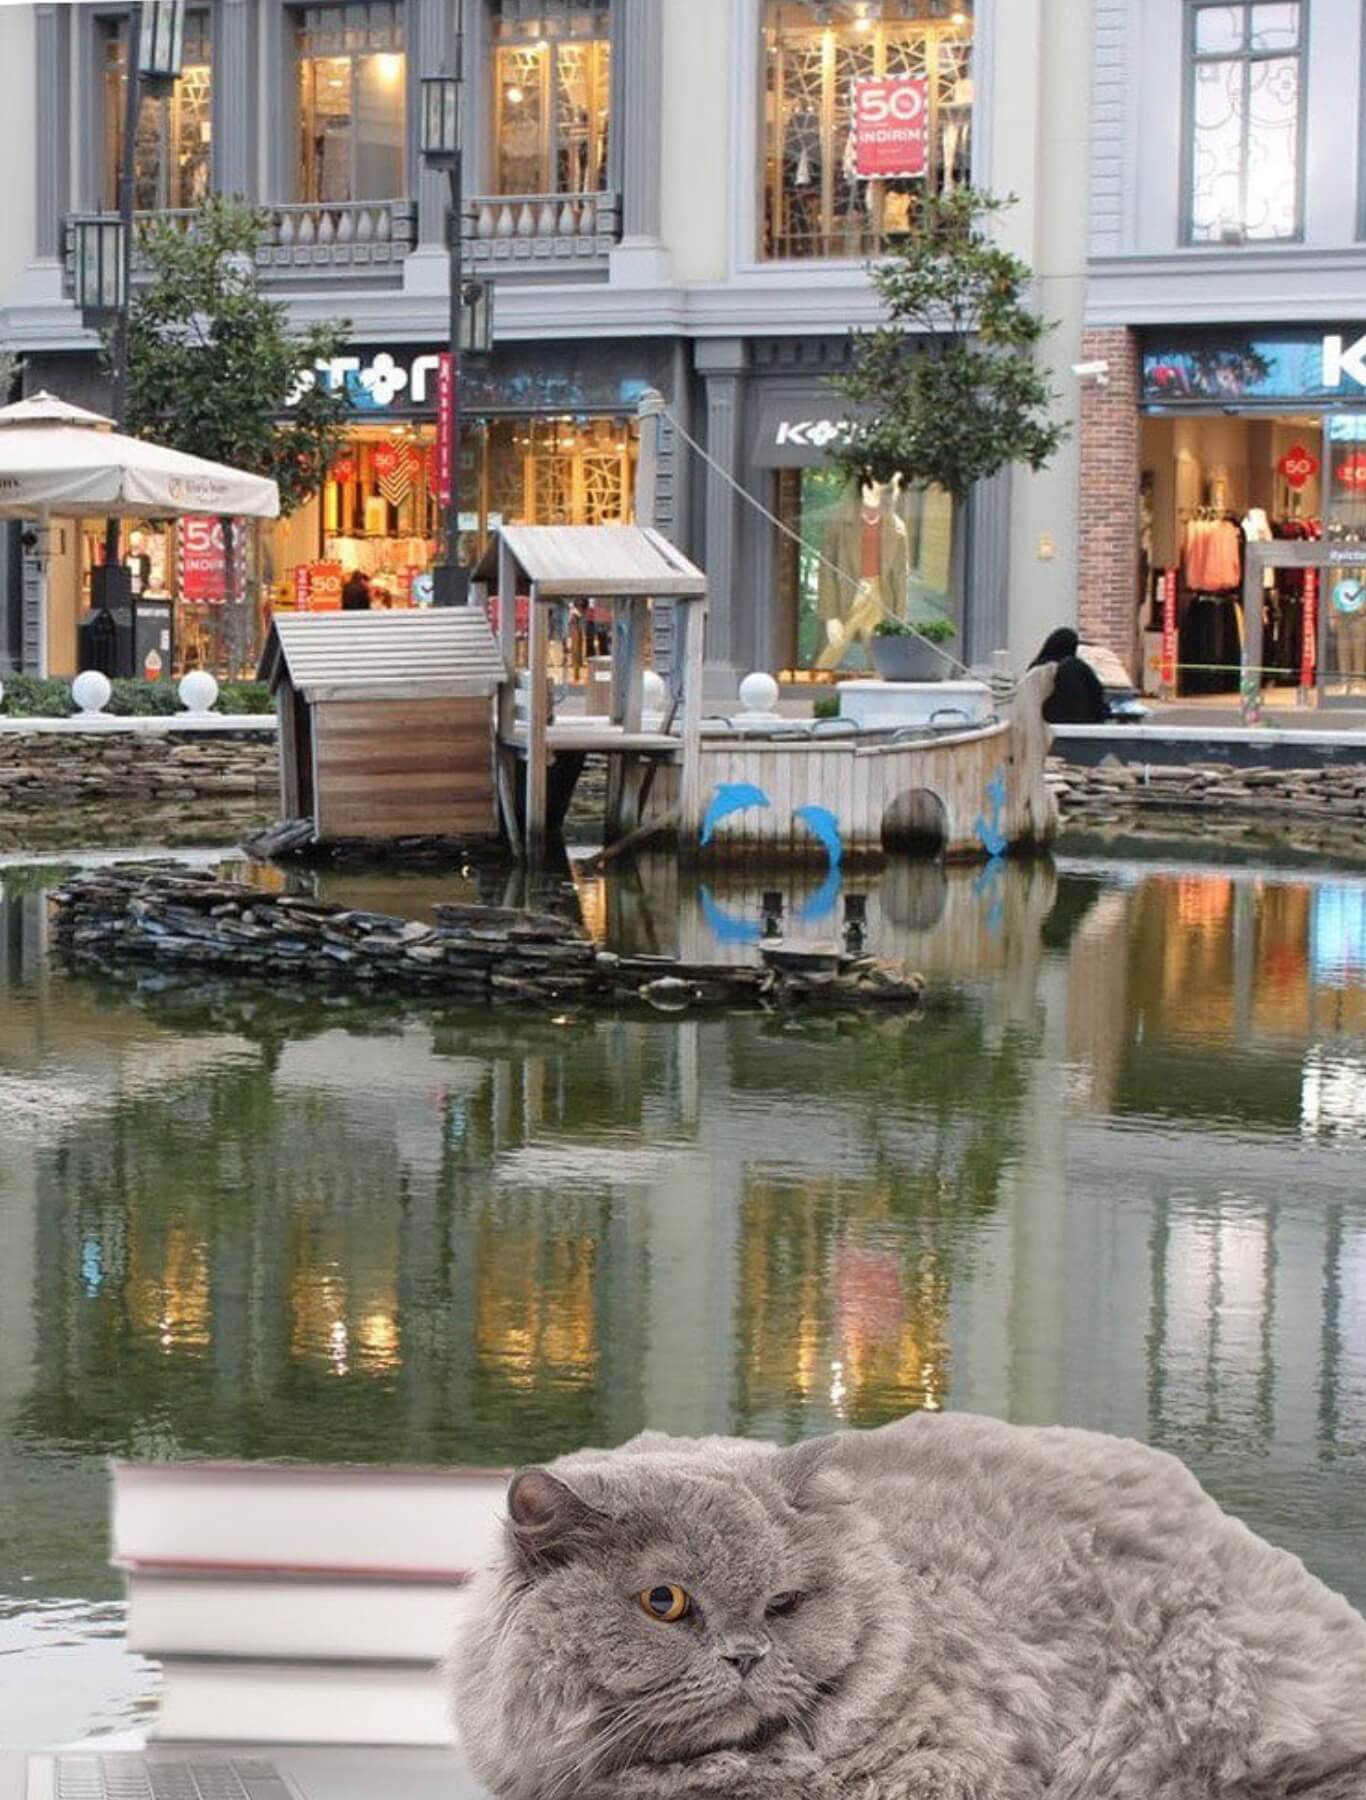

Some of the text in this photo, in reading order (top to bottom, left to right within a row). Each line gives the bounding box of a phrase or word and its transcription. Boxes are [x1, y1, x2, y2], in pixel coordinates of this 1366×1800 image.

[859, 86, 922, 121] 50
[1285, 459, 1311, 474] 50
[186, 521, 238, 551] 50
